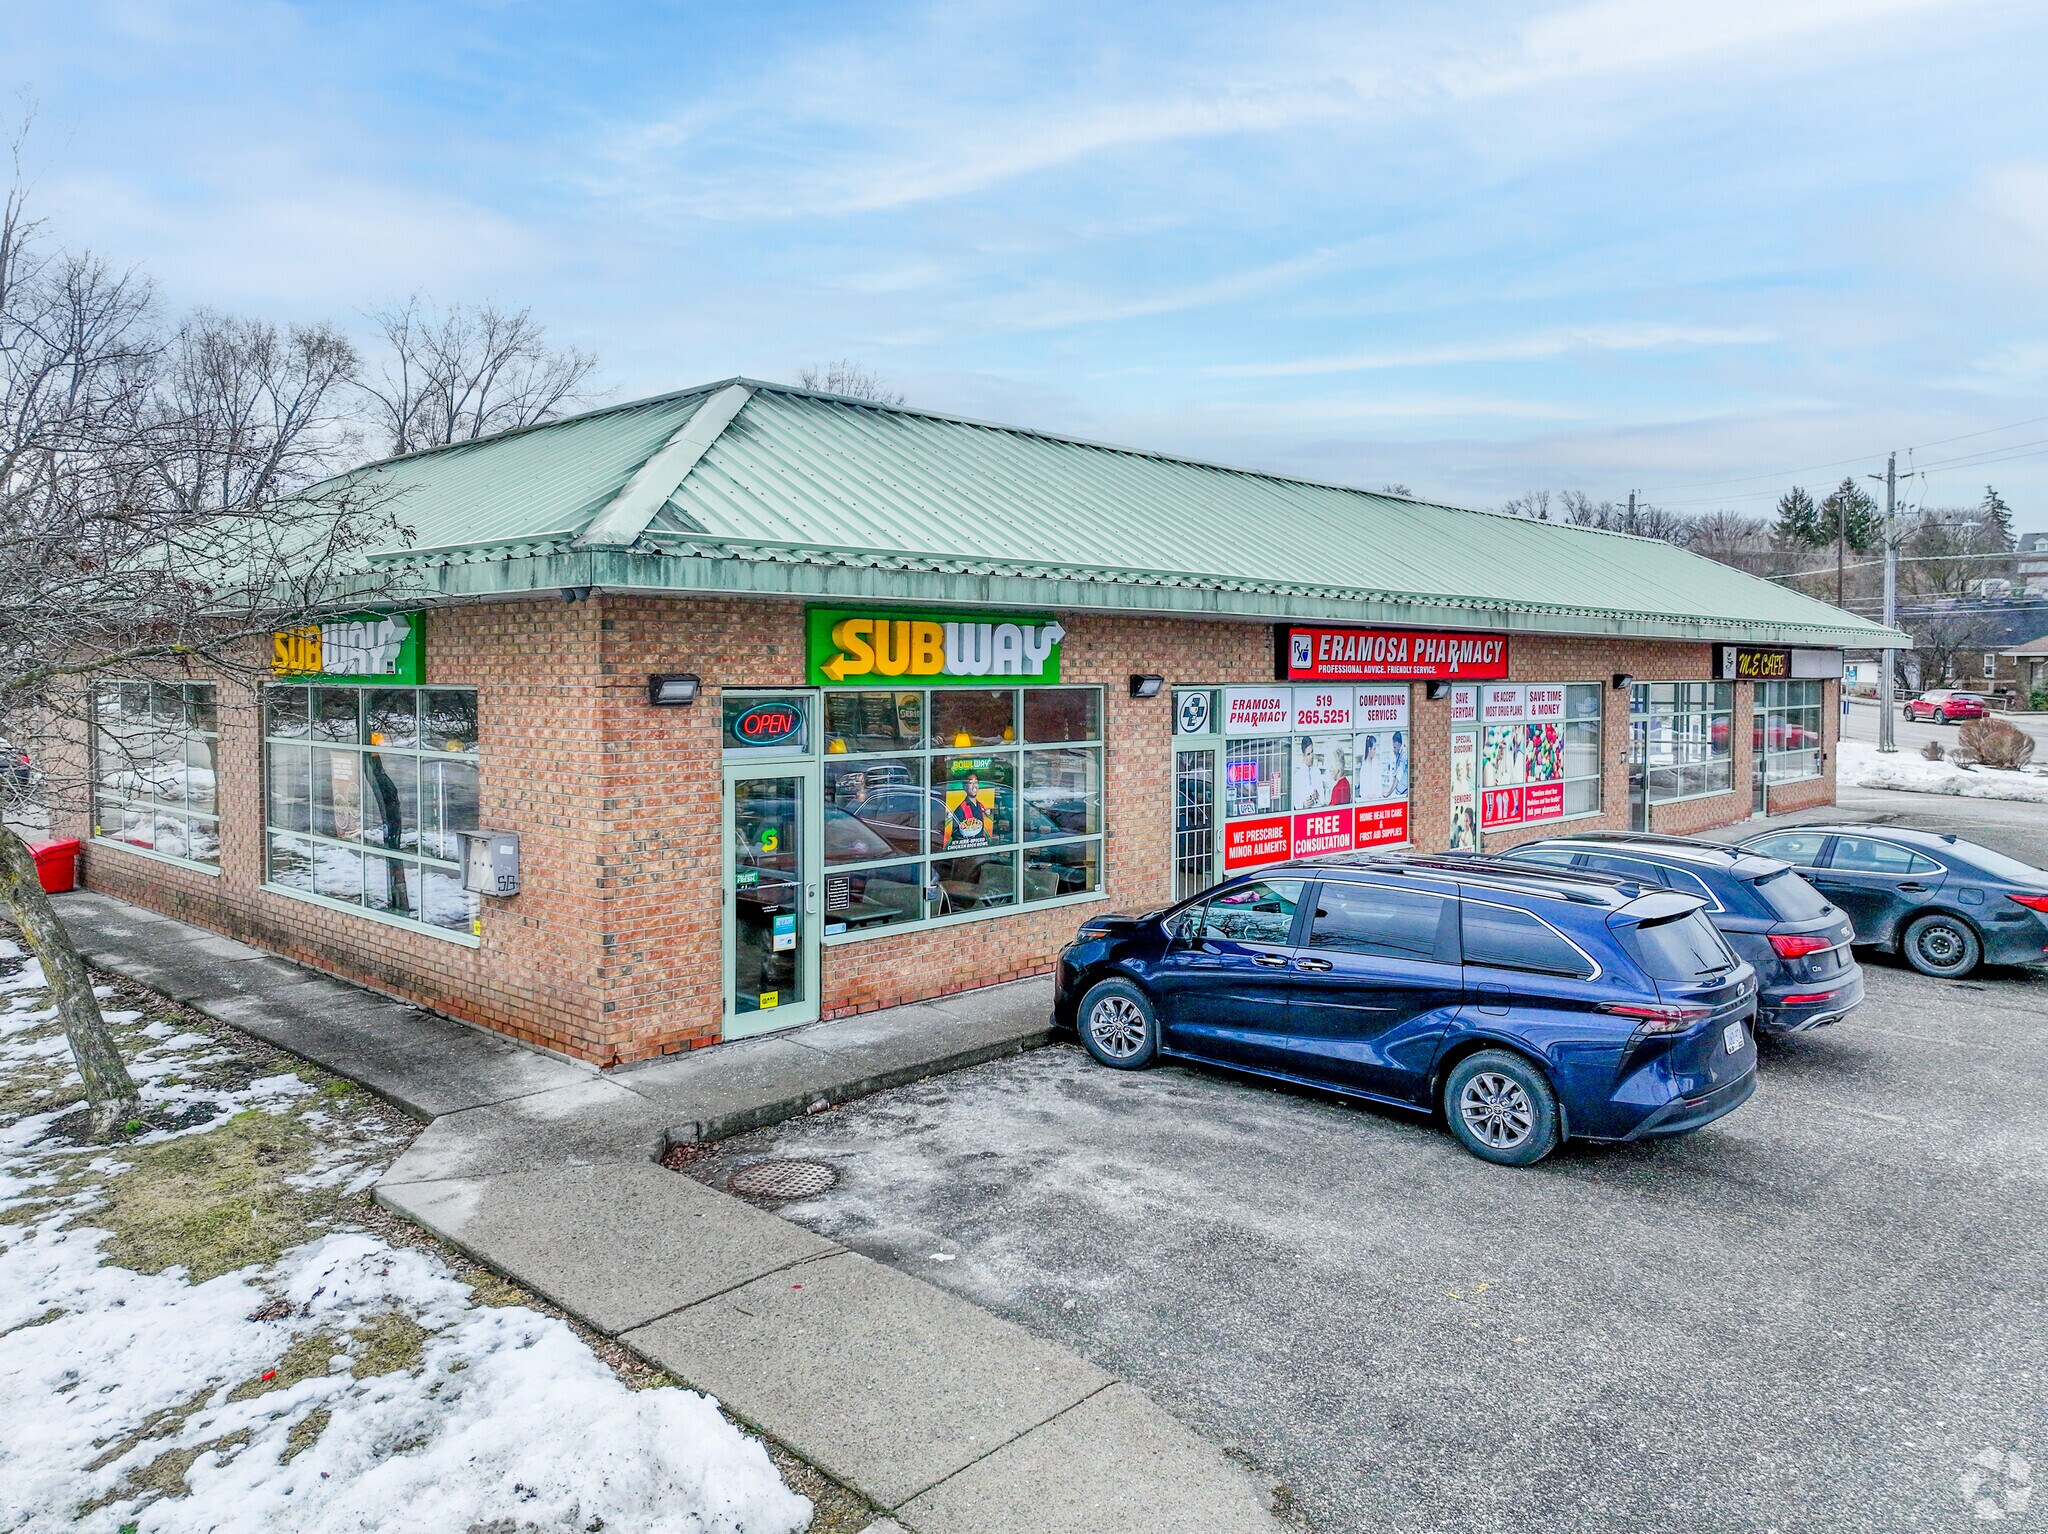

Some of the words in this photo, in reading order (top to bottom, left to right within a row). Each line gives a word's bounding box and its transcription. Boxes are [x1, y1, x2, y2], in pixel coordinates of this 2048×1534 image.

[271, 616, 411, 676] SUBWAY
[820, 618, 1066, 681] SUBWAY
[1318, 635, 1407, 662] ERAMOSA
[1414, 639, 1503, 673] PHARMACY
[1318, 664, 1363, 674] PROFESSIONAL
[1363, 665, 1387, 674] ADVICE.
[1387, 665, 1412, 674] FRIENDLY
[1413, 665, 1437, 674] SERVICE.
[1761, 654, 1784, 676] CAFE
[1316, 695, 1333, 707] 519
[1359, 694, 1406, 707] COMPOUNDING
[1455, 692, 1469, 704] SAVE
[1493, 691, 1500, 702] WE
[1500, 691, 1516, 701] ACCEPT
[1529, 691, 1546, 702] SAVE
[1547, 691, 1562, 701] TIME
[1232, 698, 1281, 710] ERAMOSA
[1531, 705, 1537, 716] &
[1538, 704, 1560, 716] MONEY
[1298, 709, 1350, 725] 265.5251
[1367, 709, 1398, 721] SERVICES
[1485, 706, 1497, 717] MOST
[1498, 706, 1509, 716] DRUG
[1510, 705, 1523, 716] PLANS
[743, 713, 793, 735] OPEN
[1229, 711, 1287, 727] PHARMACY
[1455, 735, 1472, 743] SPECIAL
[1453, 744, 1473, 754] DISCOUNT
[1229, 764, 1257, 782] OPEN
[1240, 804, 1255, 814] OPEN
[1359, 812, 1373, 822] HOME
[1373, 809, 1391, 820] HEALTH
[1391, 808, 1403, 818] CARE
[1306, 815, 1340, 837] FREE
[1378, 820, 1384, 829] &
[1233, 831, 1245, 844] WE
[1246, 826, 1283, 843] PRESCRIBE
[1359, 831, 1373, 842] FIRST
[1373, 830, 1382, 840] AID
[1382, 827, 1403, 838] SUPPLIES
[1229, 843, 1253, 859] MINOR
[1253, 839, 1287, 856] AILMENTS
[1295, 833, 1350, 854] CONSULTATION
